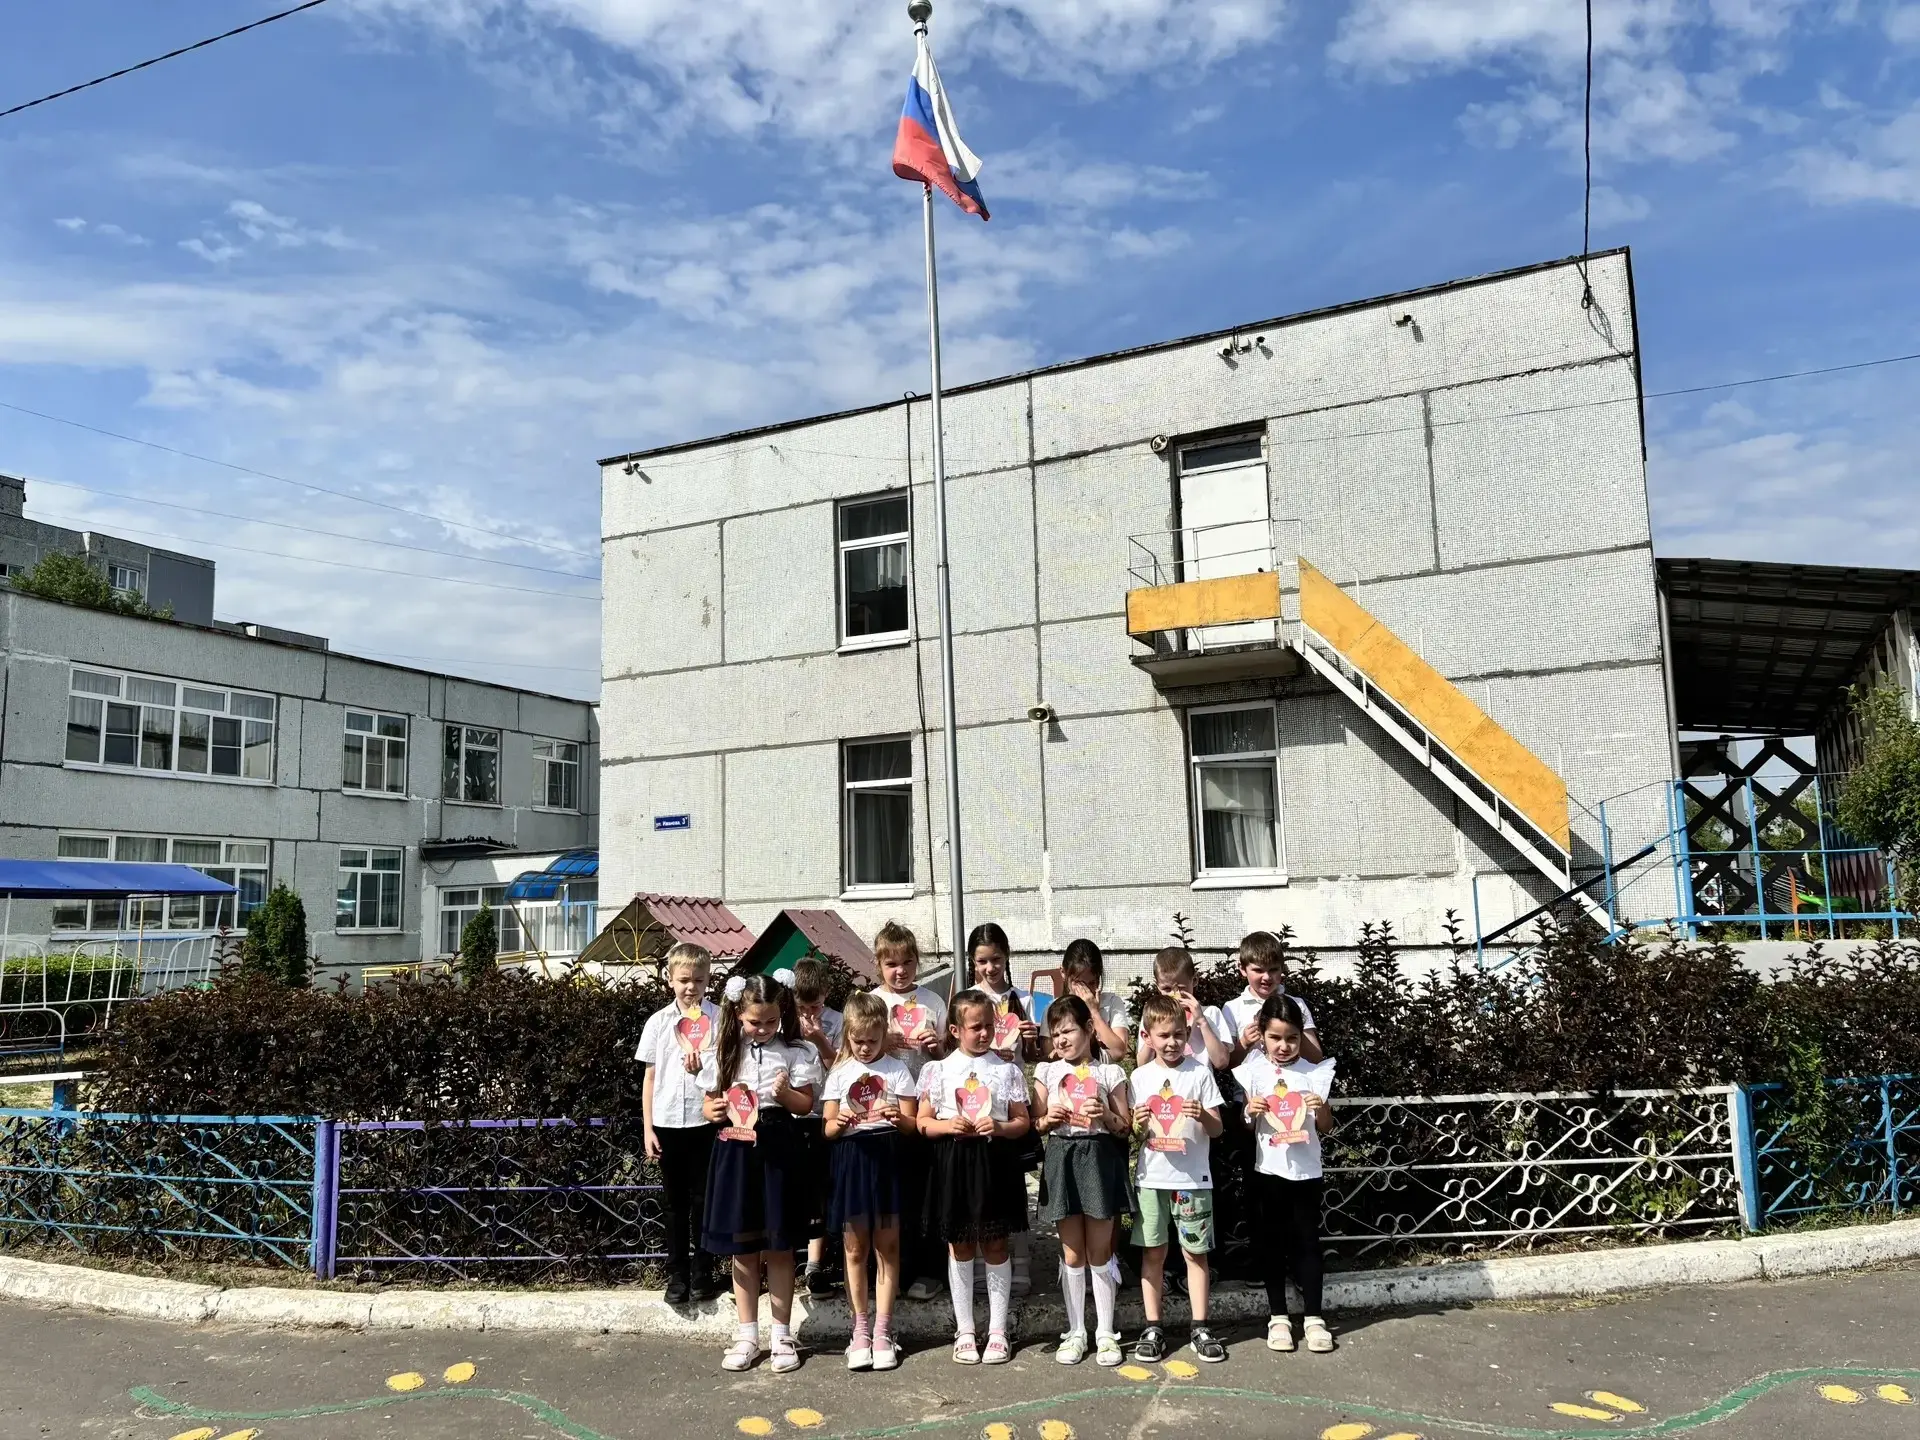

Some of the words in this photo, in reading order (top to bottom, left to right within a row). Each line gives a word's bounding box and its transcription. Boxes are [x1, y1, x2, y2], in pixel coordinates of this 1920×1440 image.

[903, 1012, 913, 1021] 22
[690, 1023, 701, 1032] 22
[860, 1085, 871, 1095] 22
[1074, 1083, 1085, 1093] 22
[739, 1094, 749, 1105] 22
[859, 1094, 876, 1102] ИЮНЯ
[967, 1095, 977, 1103] 22
[1160, 1103, 1171, 1113] 22
[1278, 1101, 1290, 1111] 22
